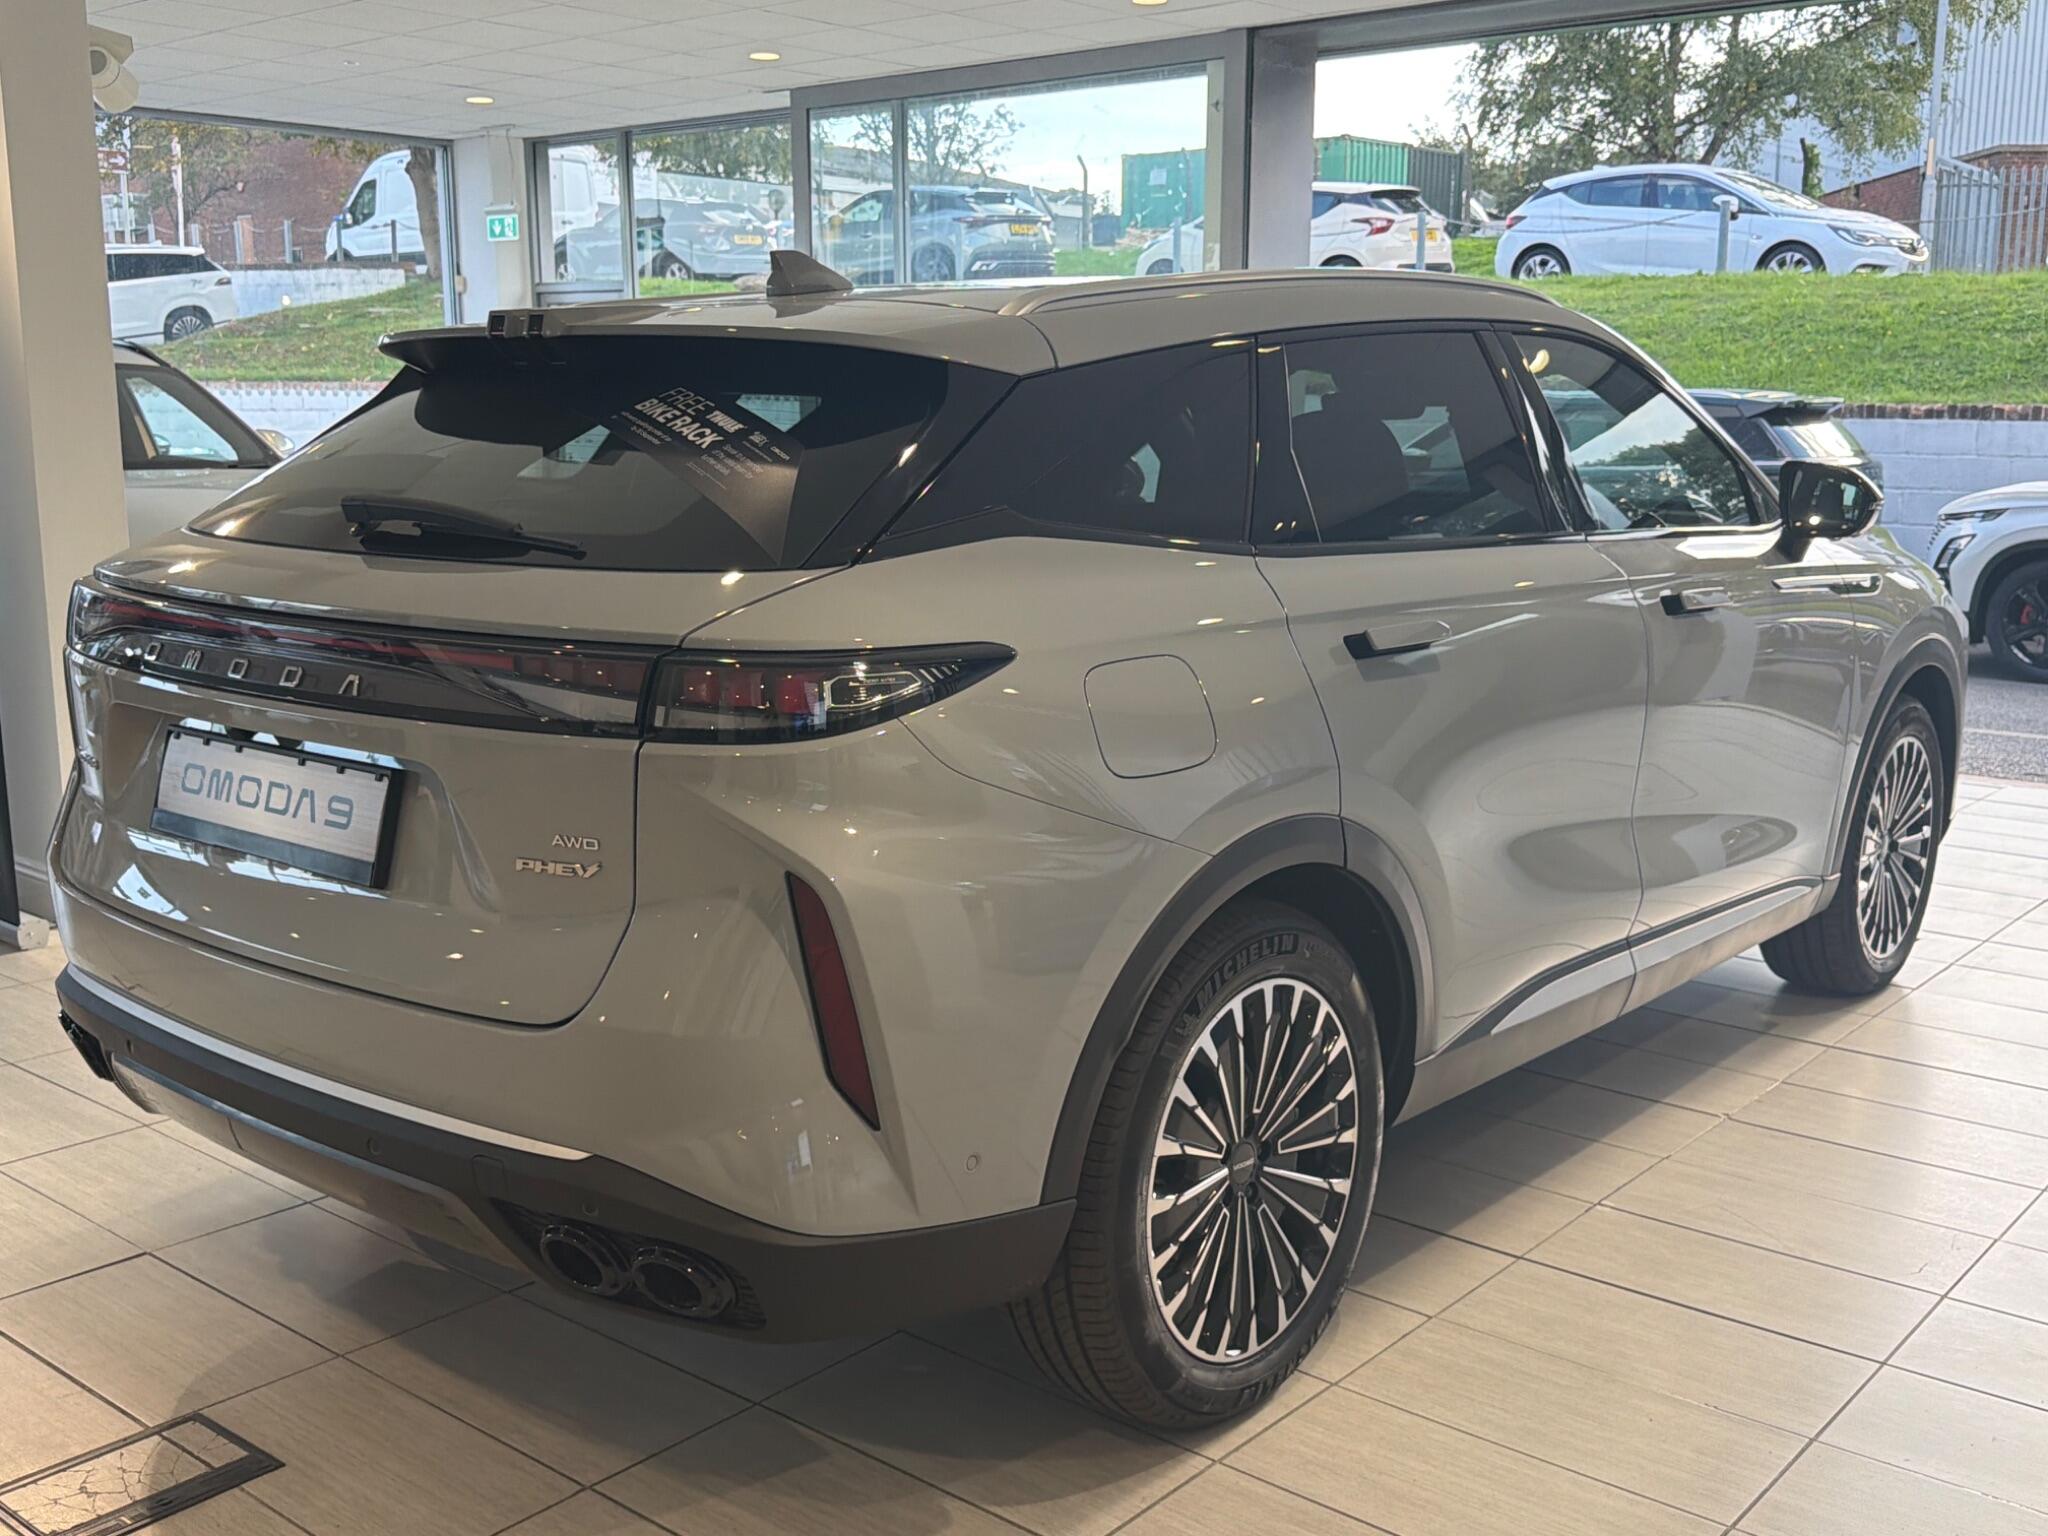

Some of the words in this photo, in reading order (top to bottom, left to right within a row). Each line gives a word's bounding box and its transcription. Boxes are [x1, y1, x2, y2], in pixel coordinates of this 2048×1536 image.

[658, 387, 715, 416] FREE
[634, 399, 679, 424] BIKE
[666, 416, 724, 449] RACK
[705, 410, 745, 433] THULE
[143, 641, 361, 697] OMODA
[551, 834, 599, 851] AWD
[515, 857, 601, 878] PHEV
[1197, 934, 1294, 1011] MICHELIN
